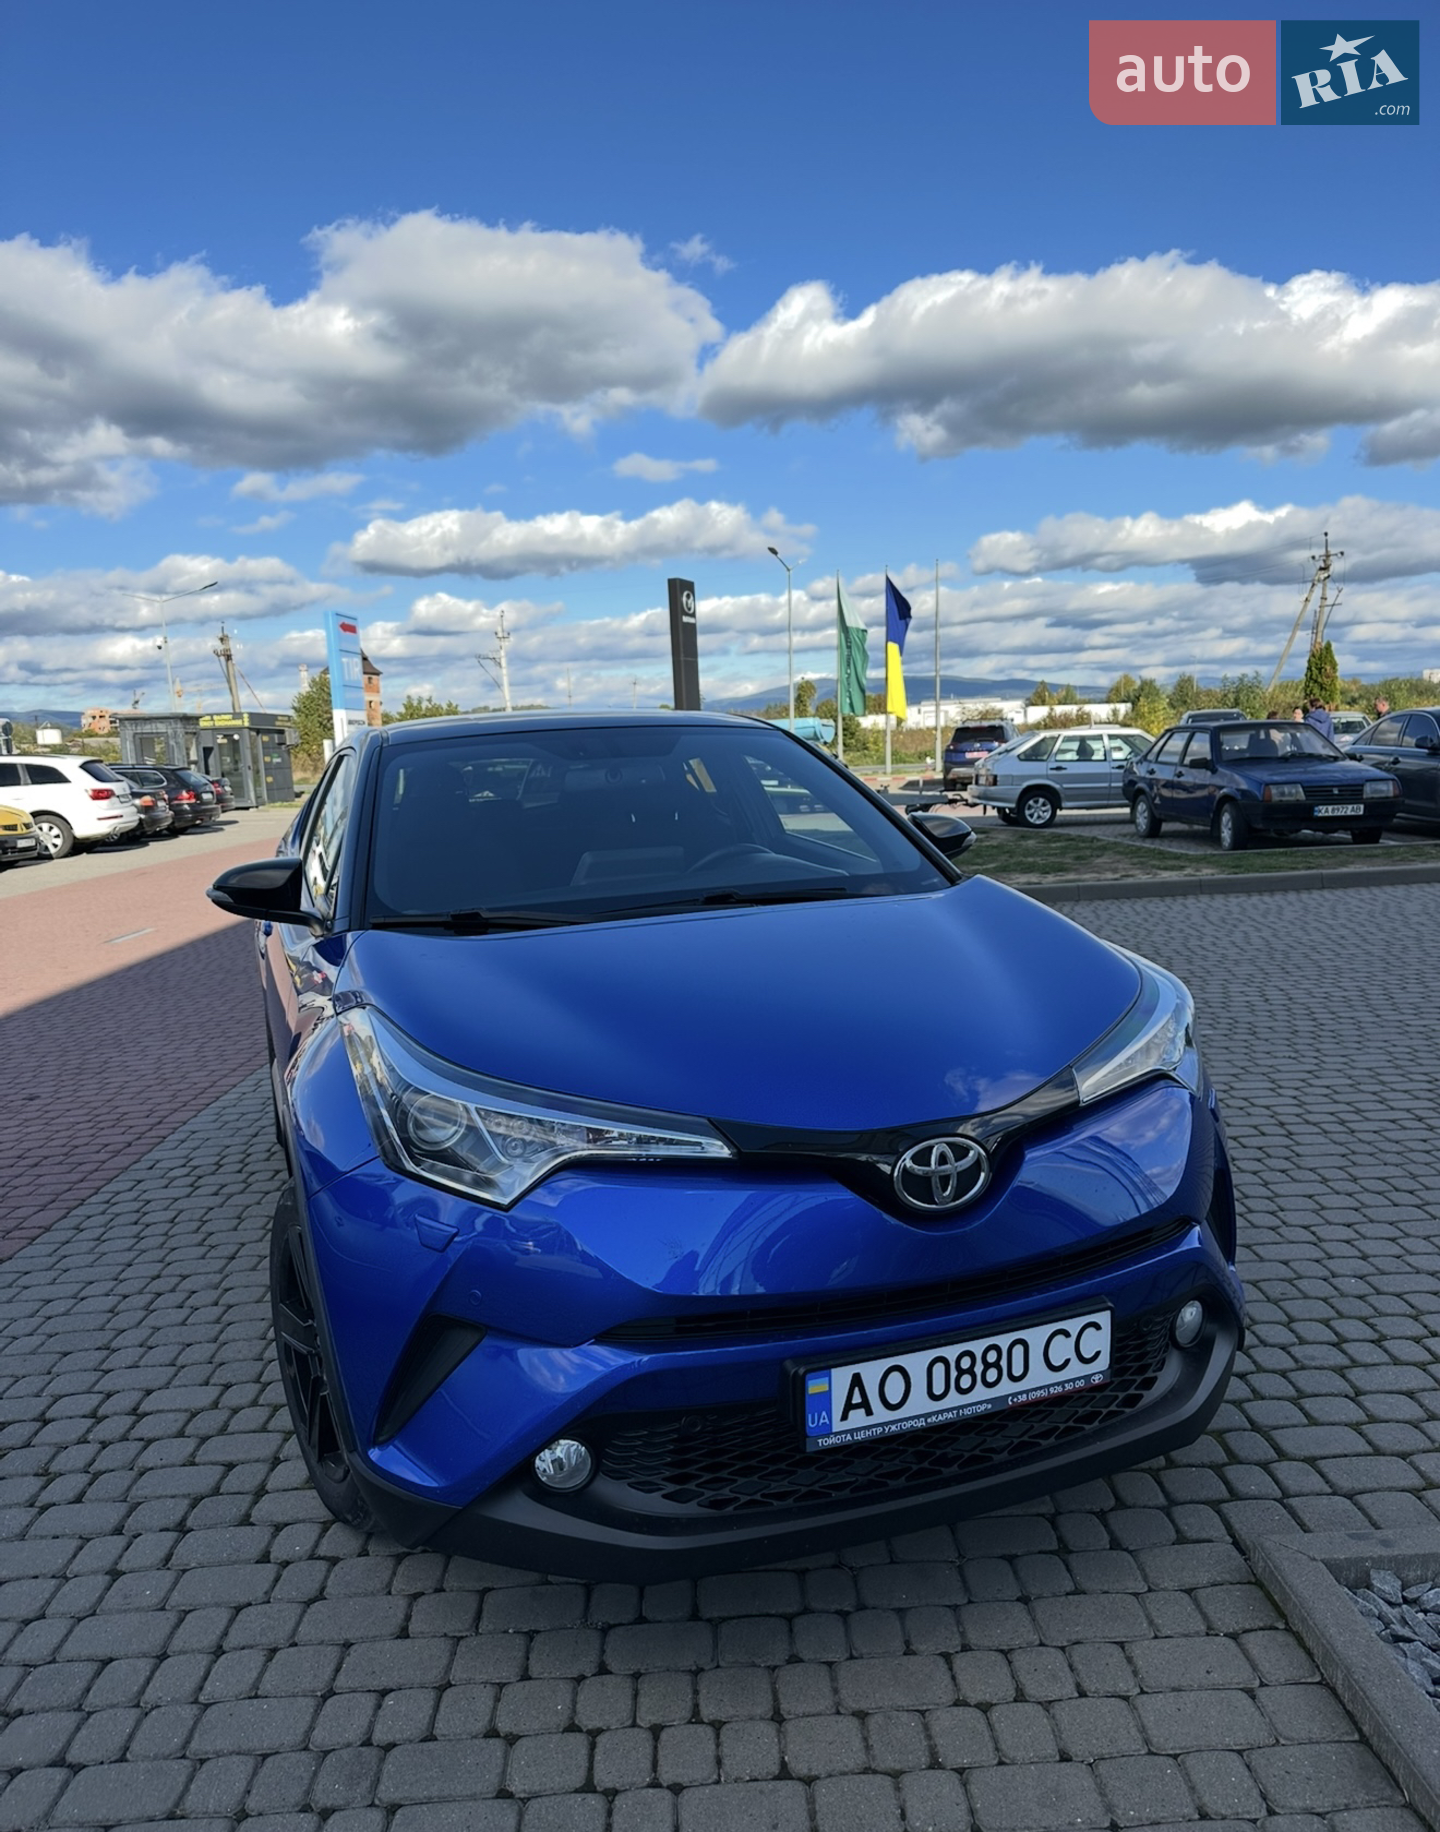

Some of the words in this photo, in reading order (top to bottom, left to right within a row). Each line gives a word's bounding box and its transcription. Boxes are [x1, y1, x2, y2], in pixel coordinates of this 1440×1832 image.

[341, 657, 361, 681] TIR
[839, 1364, 911, 1422] AO
[926, 1338, 1029, 1402] 0880
[1043, 1321, 1103, 1372] CC
[1012, 1392, 1028, 1404] +38
[1028, 1387, 1048, 1401] (095)
[1049, 1384, 1063, 1395] 926
[1064, 1381, 1074, 1391] 30
[1075, 1379, 1085, 1388] 00
[808, 1411, 830, 1428] UA
[817, 1432, 853, 1447] ТОЙОТА
[853, 1426, 883, 1441] ЦЕНТР
[884, 1418, 926, 1434] УЖГОРОД
[926, 1410, 958, 1424] «КАРАТ
